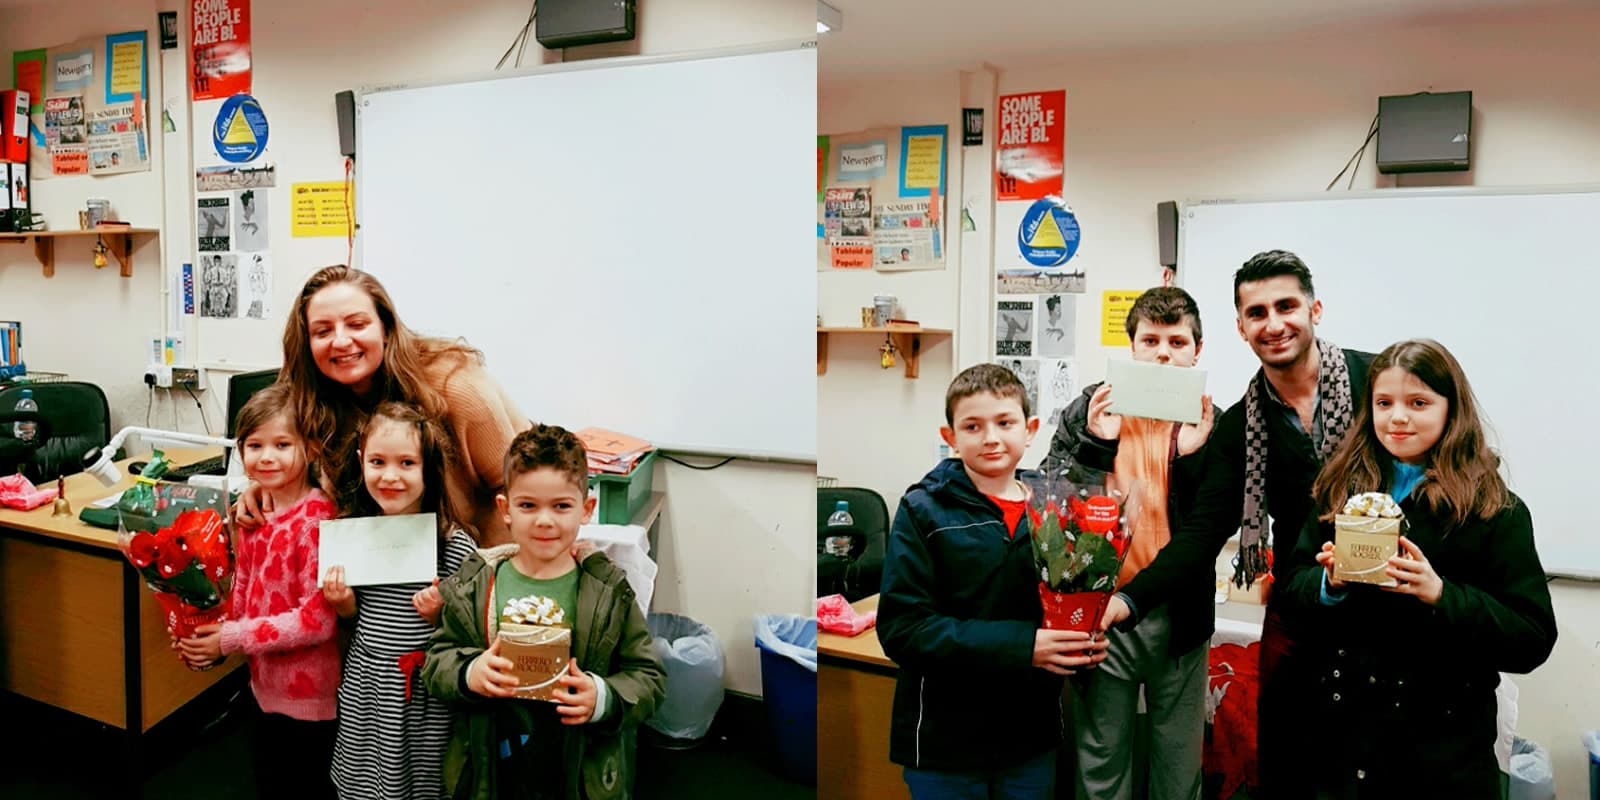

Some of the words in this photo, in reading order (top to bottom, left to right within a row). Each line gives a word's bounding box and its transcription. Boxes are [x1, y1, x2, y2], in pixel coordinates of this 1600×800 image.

[194, 0, 229, 15] SOME
[194, 8, 241, 31] PEOPLE
[194, 28, 219, 46] ARE
[194, 78, 210, 93] IT!
[1002, 95, 1042, 113] SOME
[1002, 109, 1055, 130] PEOPLE
[1001, 129, 1029, 145] ARE
[1000, 178, 1017, 193] IT!
